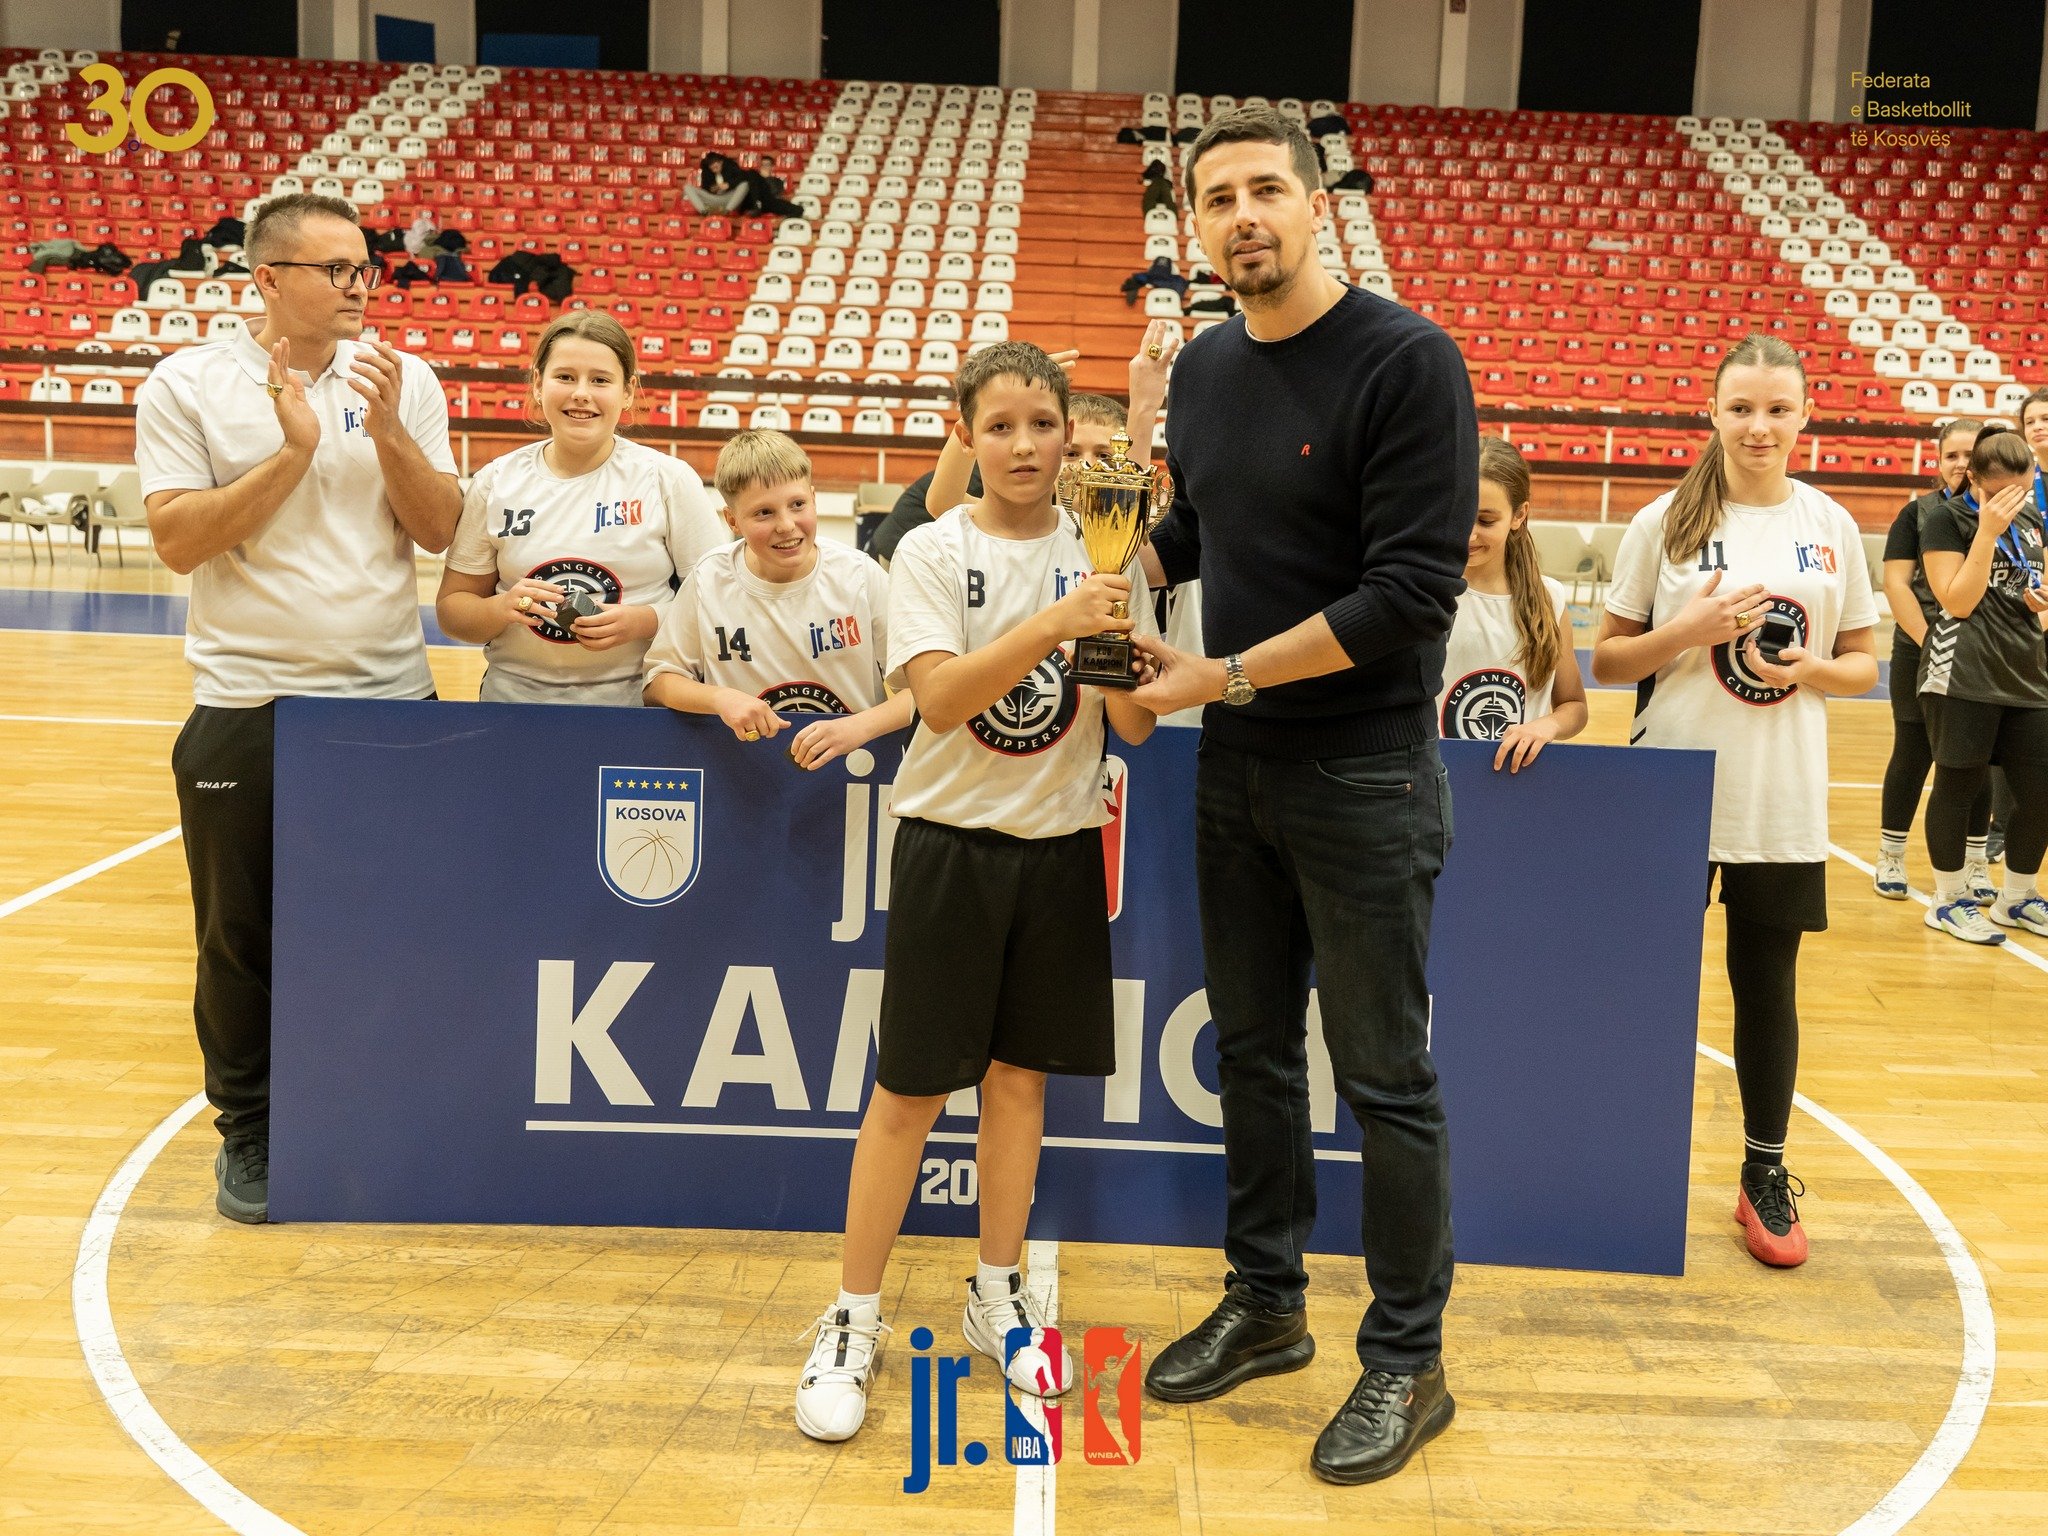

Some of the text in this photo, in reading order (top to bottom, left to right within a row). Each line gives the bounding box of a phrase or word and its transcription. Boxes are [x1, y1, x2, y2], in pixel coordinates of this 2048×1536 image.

[344, 407, 359, 433] jr.
[498, 508, 536, 538] 13
[594, 502, 612, 533] jr.
[1698, 540, 1728, 572] 11
[1794, 541, 1814, 573] jr.
[715, 626, 752, 661] 14
[809, 622, 831, 660] jr.
[1083, 656, 1123, 667] KAMPION
[778, 686, 845, 713] ANGELES
[1449, 674, 1525, 710] LOS ANGEL
[1726, 676, 1791, 700] CLIPPE
[975, 720, 1061, 750] CLIPPERS
[195, 781, 238, 789] SHAFF
[616, 807, 687, 821] KOSOVA
